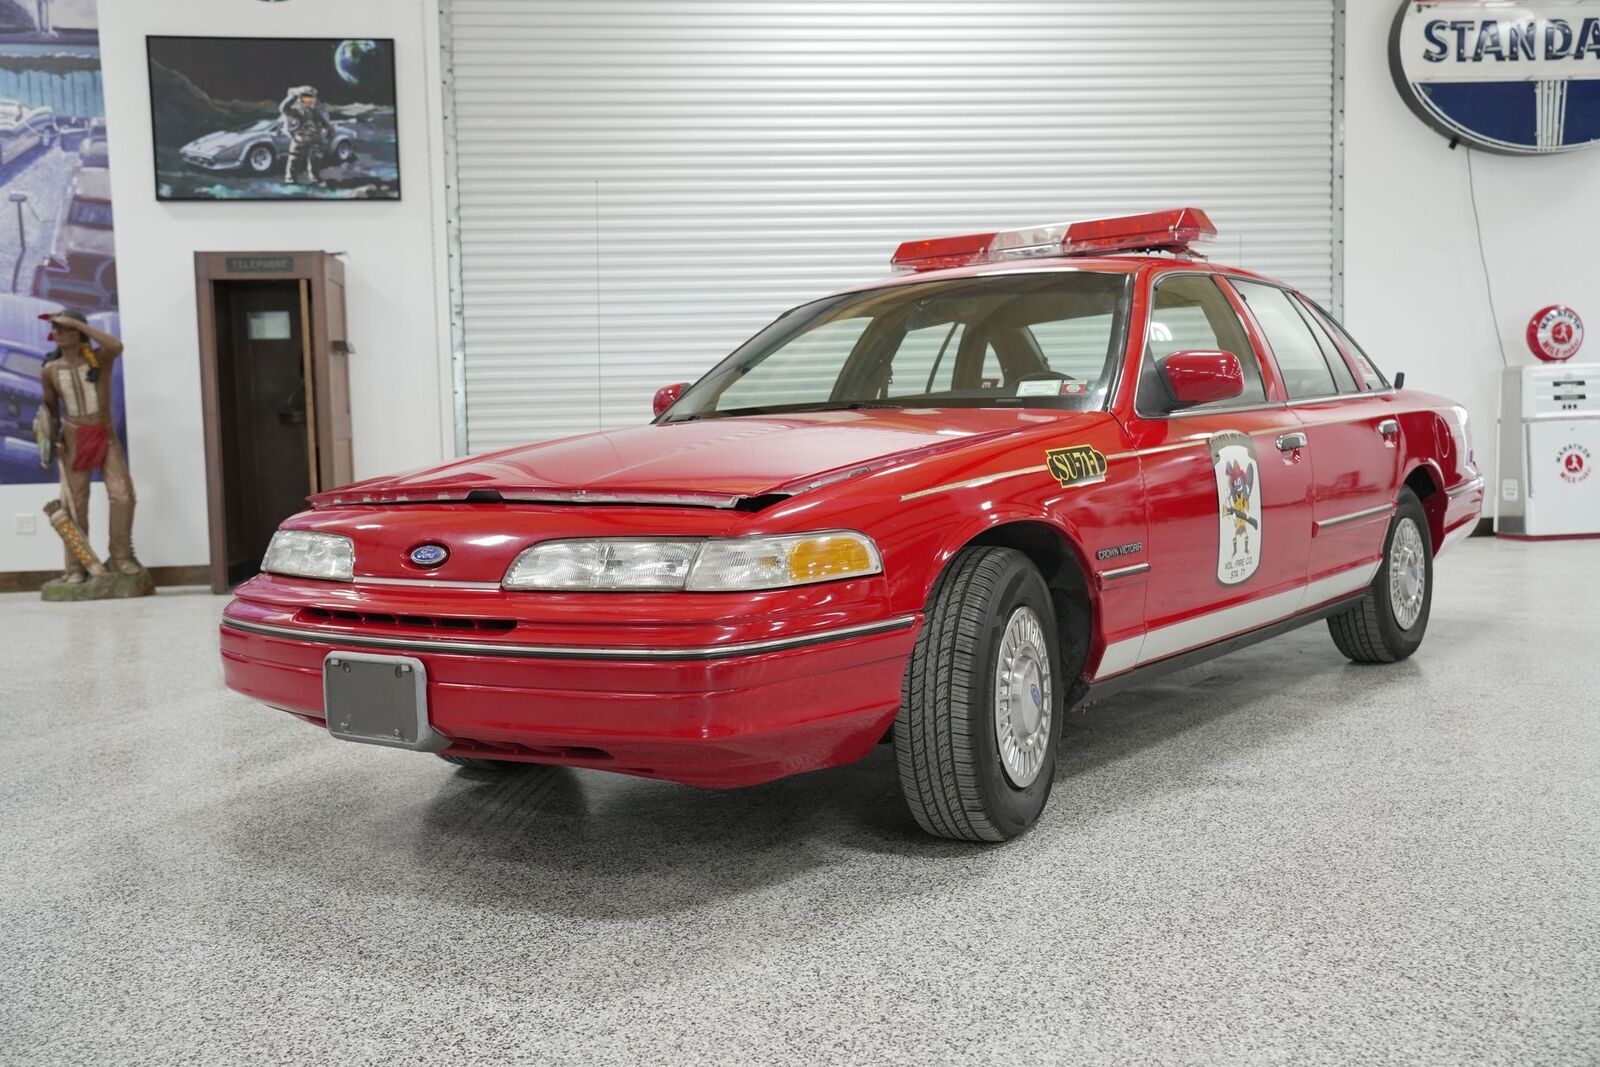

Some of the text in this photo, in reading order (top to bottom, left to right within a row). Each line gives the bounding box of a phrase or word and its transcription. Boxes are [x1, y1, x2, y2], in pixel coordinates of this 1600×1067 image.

[1423, 17, 1600, 63] STANDA
[231, 259, 290, 270] TELEPHONE
[417, 547, 439, 560] Ford
[1098, 542, 1143, 560] CROWN VICTORIA
